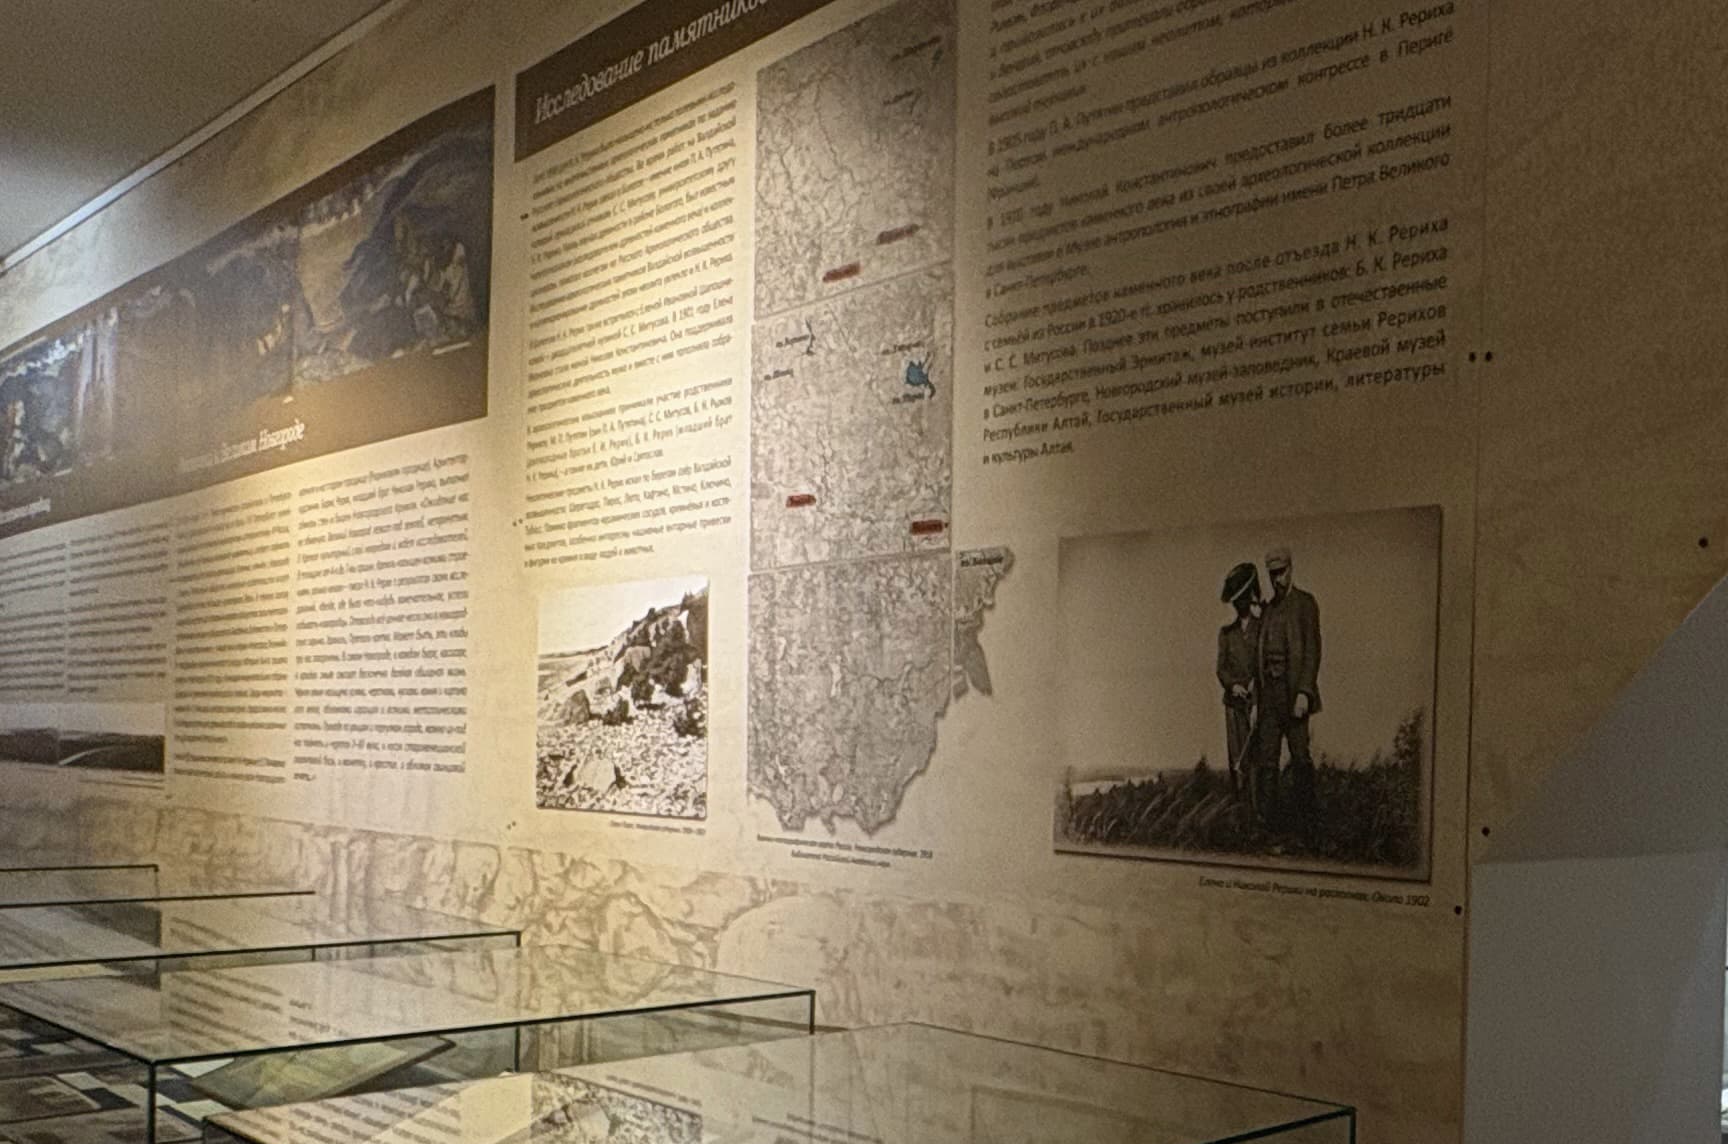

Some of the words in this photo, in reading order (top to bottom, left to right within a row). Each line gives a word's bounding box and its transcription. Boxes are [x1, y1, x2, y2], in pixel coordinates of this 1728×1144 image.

[536, 50, 643, 124] Исследование
[647, 0, 767, 65] памятник
[1024, 127, 1045, 143] году
[1201, 61, 1258, 88] образцы
[1261, 55, 1277, 69] из
[1280, 30, 1359, 64] коллекции
[1380, 16, 1394, 34] К.
[1398, 2, 1455, 29] Рериха
[1157, 78, 1288, 127] антропологическом
[1297, 54, 1370, 85] конгрессе
[1115, 157, 1216, 193] Константинович
[1224, 131, 1314, 166] предоставил
[1323, 117, 1368, 139] более
[1376, 96, 1451, 127] тридцати
[1147, 193, 1175, 210] века
[1178, 189, 1194, 202] из
[1197, 173, 1236, 198] своей
[1240, 141, 1362, 189] археологической
[1367, 124, 1450, 156] коллекции
[1201, 194, 1278, 222] этнографии
[1281, 182, 1327, 204] имени
[1331, 171, 1375, 192] Петра
[1378, 153, 1450, 181] Великого
[984, 305, 1040, 326] Собрание
[1041, 290, 1109, 316] предметов
[1112, 273, 1185, 299] каменного
[1189, 266, 1221, 283] века
[1226, 255, 1271, 275] после
[1275, 241, 1339, 264] отъезда
[1367, 228, 1384, 246] К.
[1388, 218, 1448, 241] Рериха
[1031, 328, 1044, 340] из
[1047, 319, 1086, 337] России
[1099, 307, 1137, 326] 1920-е
[1157, 291, 1223, 317] хранилось
[1355, 259, 1368, 276] Б.
[1373, 255, 1387, 273] К.
[1392, 247, 1448, 270] Рериха
[1083, 335, 1132, 353] Позднее
[1137, 329, 1159, 344] эти
[1163, 316, 1230, 341] предметы
[1235, 301, 1310, 325] поступили
[1330, 275, 1448, 308] отечественные
[992, 391, 1090, 417] Санкт-Петербурге,
[1095, 371, 1182, 400] Новгородский
[1326, 337, 1390, 365] Краевой
[1395, 328, 1445, 354] музей
[1023, 356, 1126, 388] Государственный
[1130, 348, 1194, 372] Эрмитаж,
[1322, 318, 1371, 336] семьи
[1377, 305, 1447, 328] Рерихов
[982, 421, 1048, 441] Республики
[1052, 411, 1091, 430] Алтай,
[1097, 391, 1213, 424] Государственный
[1218, 384, 1263, 408] музей
[1268, 377, 1339, 398] истории,
[1344, 362, 1445, 387] литературы
[991, 447, 1038, 466] культуры
[1039, 441, 1074, 456] Алтая.
